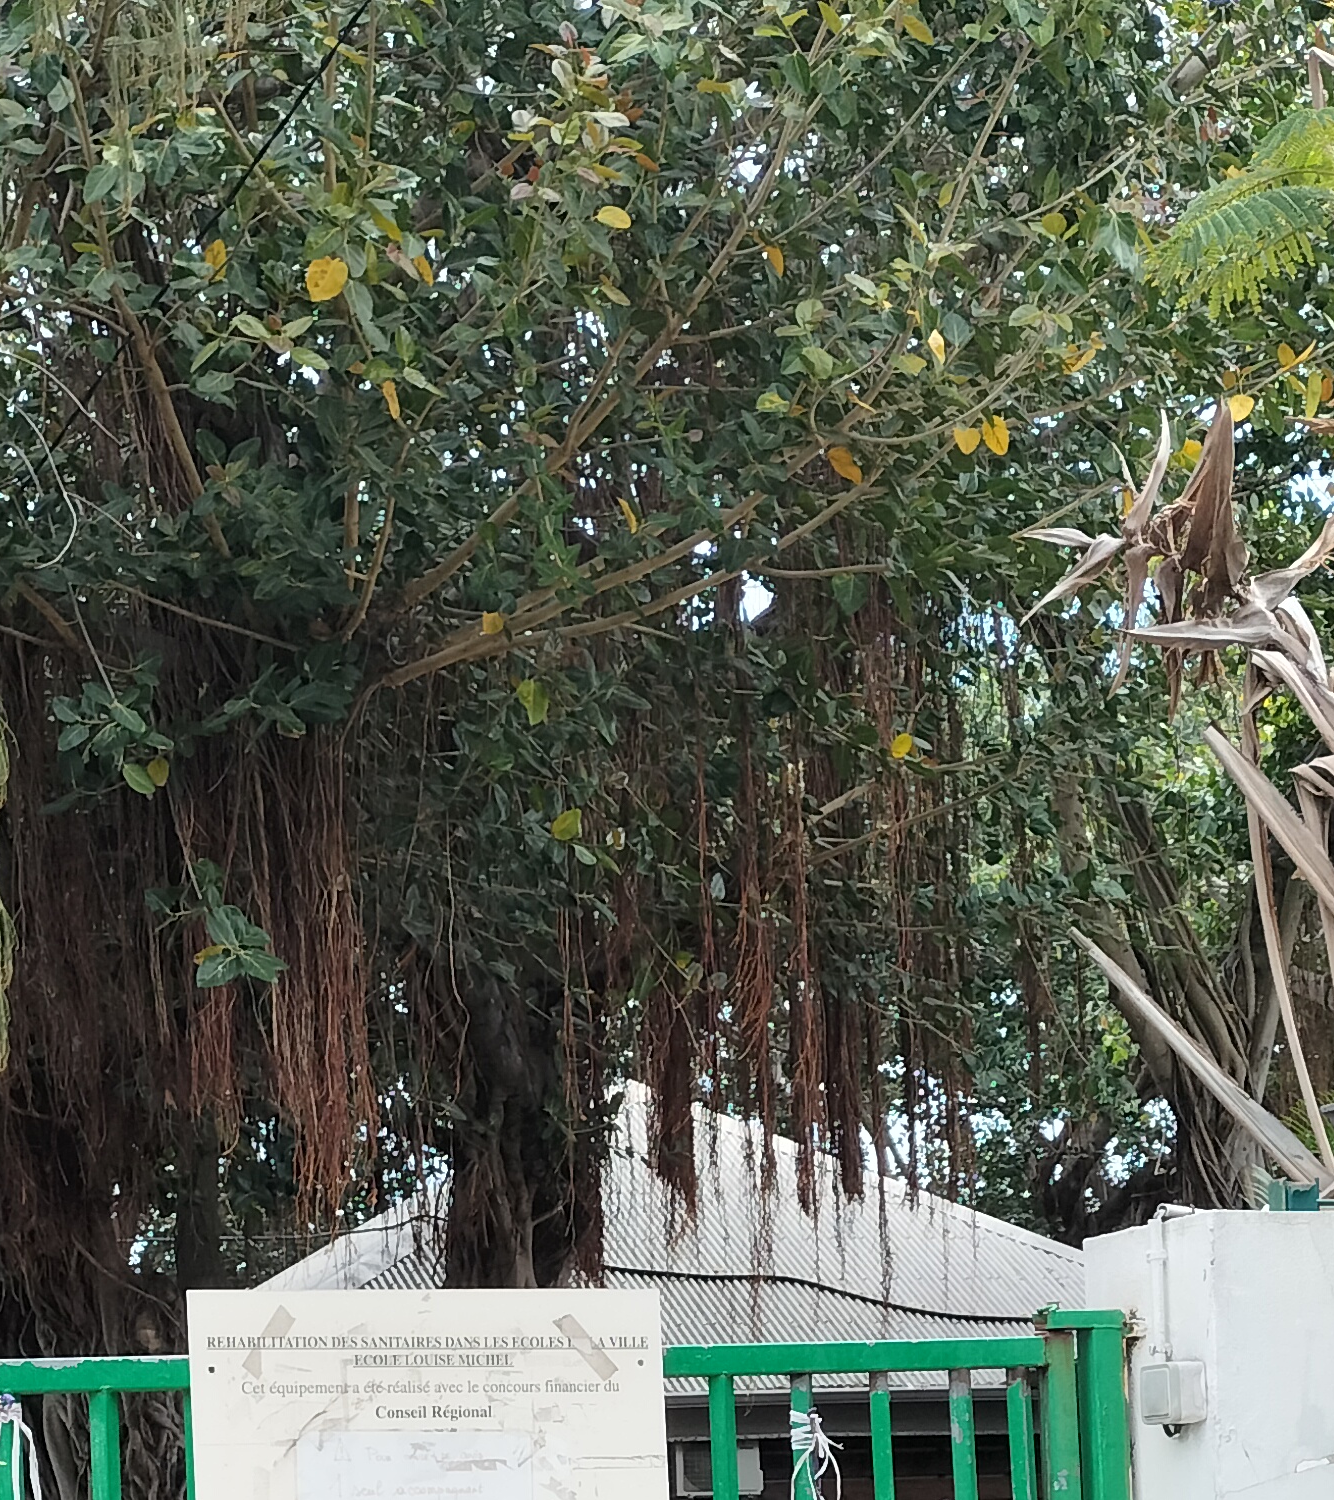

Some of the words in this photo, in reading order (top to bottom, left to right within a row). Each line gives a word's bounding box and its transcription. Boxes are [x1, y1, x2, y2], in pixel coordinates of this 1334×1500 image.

[206, 1336, 328, 1349] REHABILITATION
[332, 1336, 358, 1349] DES
[360, 1336, 441, 1349] SANITAIRES
[445, 1336, 481, 1348] DANS
[484, 1336, 509, 1348] LES
[512, 1336, 564, 1348] ECOLES
[609, 1336, 648, 1348] VILLE
[353, 1354, 402, 1366] ECOLE
[405, 1354, 455, 1366] LOUISE
[458, 1354, 513, 1366] MICHEL
[241, 1381, 265, 1395] Cet
[269, 1380, 348, 1397] équipement
[352, 1384, 360, 1394] a
[387, 1379, 430, 1394] réalisé
[434, 1383, 463, 1394] avec
[467, 1380, 479, 1393] le
[482, 1382, 541, 1394] concours
[545, 1379, 601, 1393] financier
[603, 1379, 620, 1393] du
[375, 1405, 427, 1419] Conseil
[431, 1404, 493, 1421] Régional
